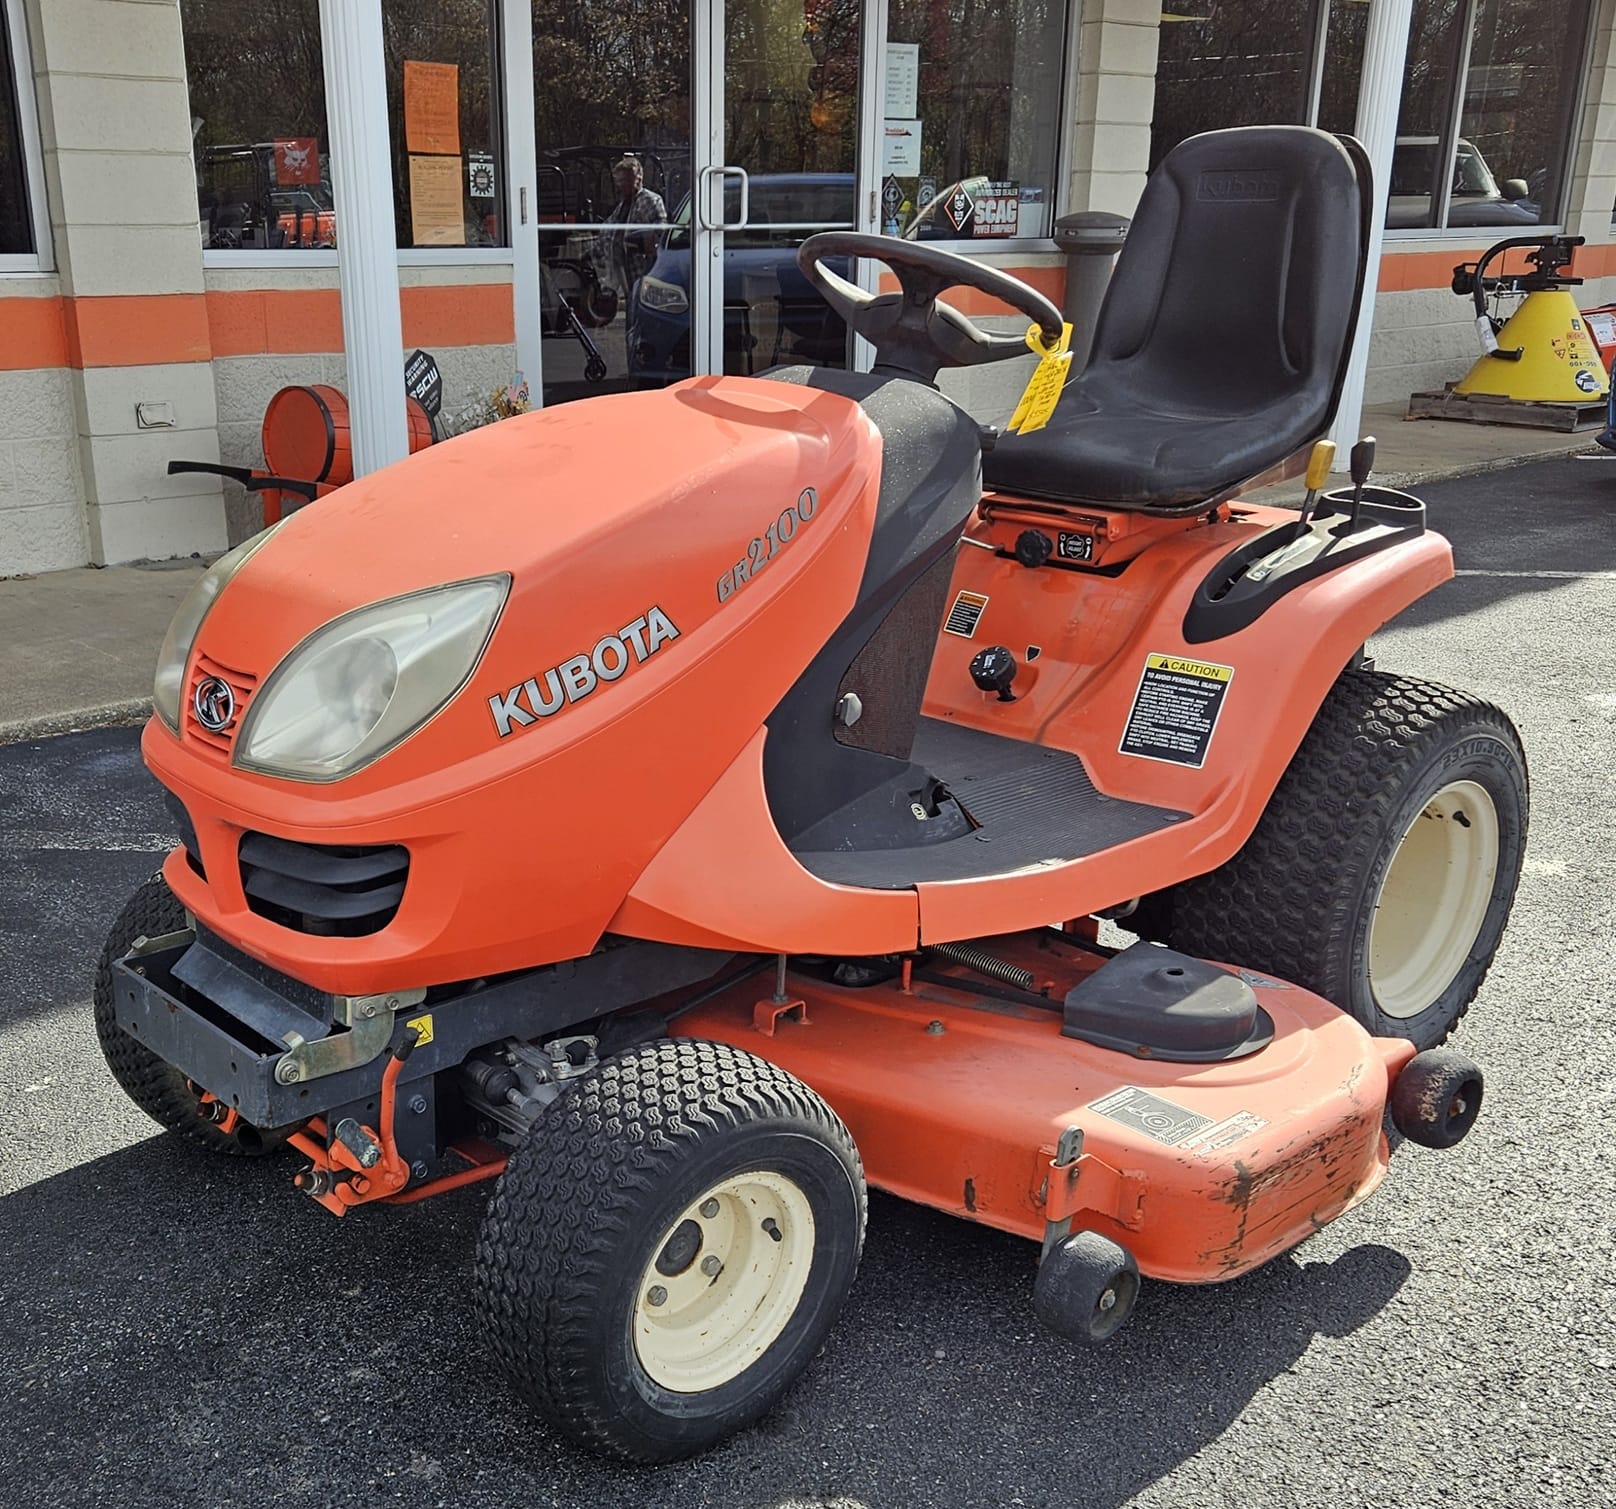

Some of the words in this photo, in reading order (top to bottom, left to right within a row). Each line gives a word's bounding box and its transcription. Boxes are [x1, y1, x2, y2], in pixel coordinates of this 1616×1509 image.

[974, 199, 1018, 224] SCAG
[415, 367, 438, 399] SCW
[716, 486, 818, 604] GR2100
[488, 604, 682, 739] KUBOTA
[1146, 671, 1155, 679] TO
[1154, 673, 1172, 682] AVOID
[1171, 676, 1201, 687] PERSONAL
[1170, 661, 1220, 677] CAUTION
